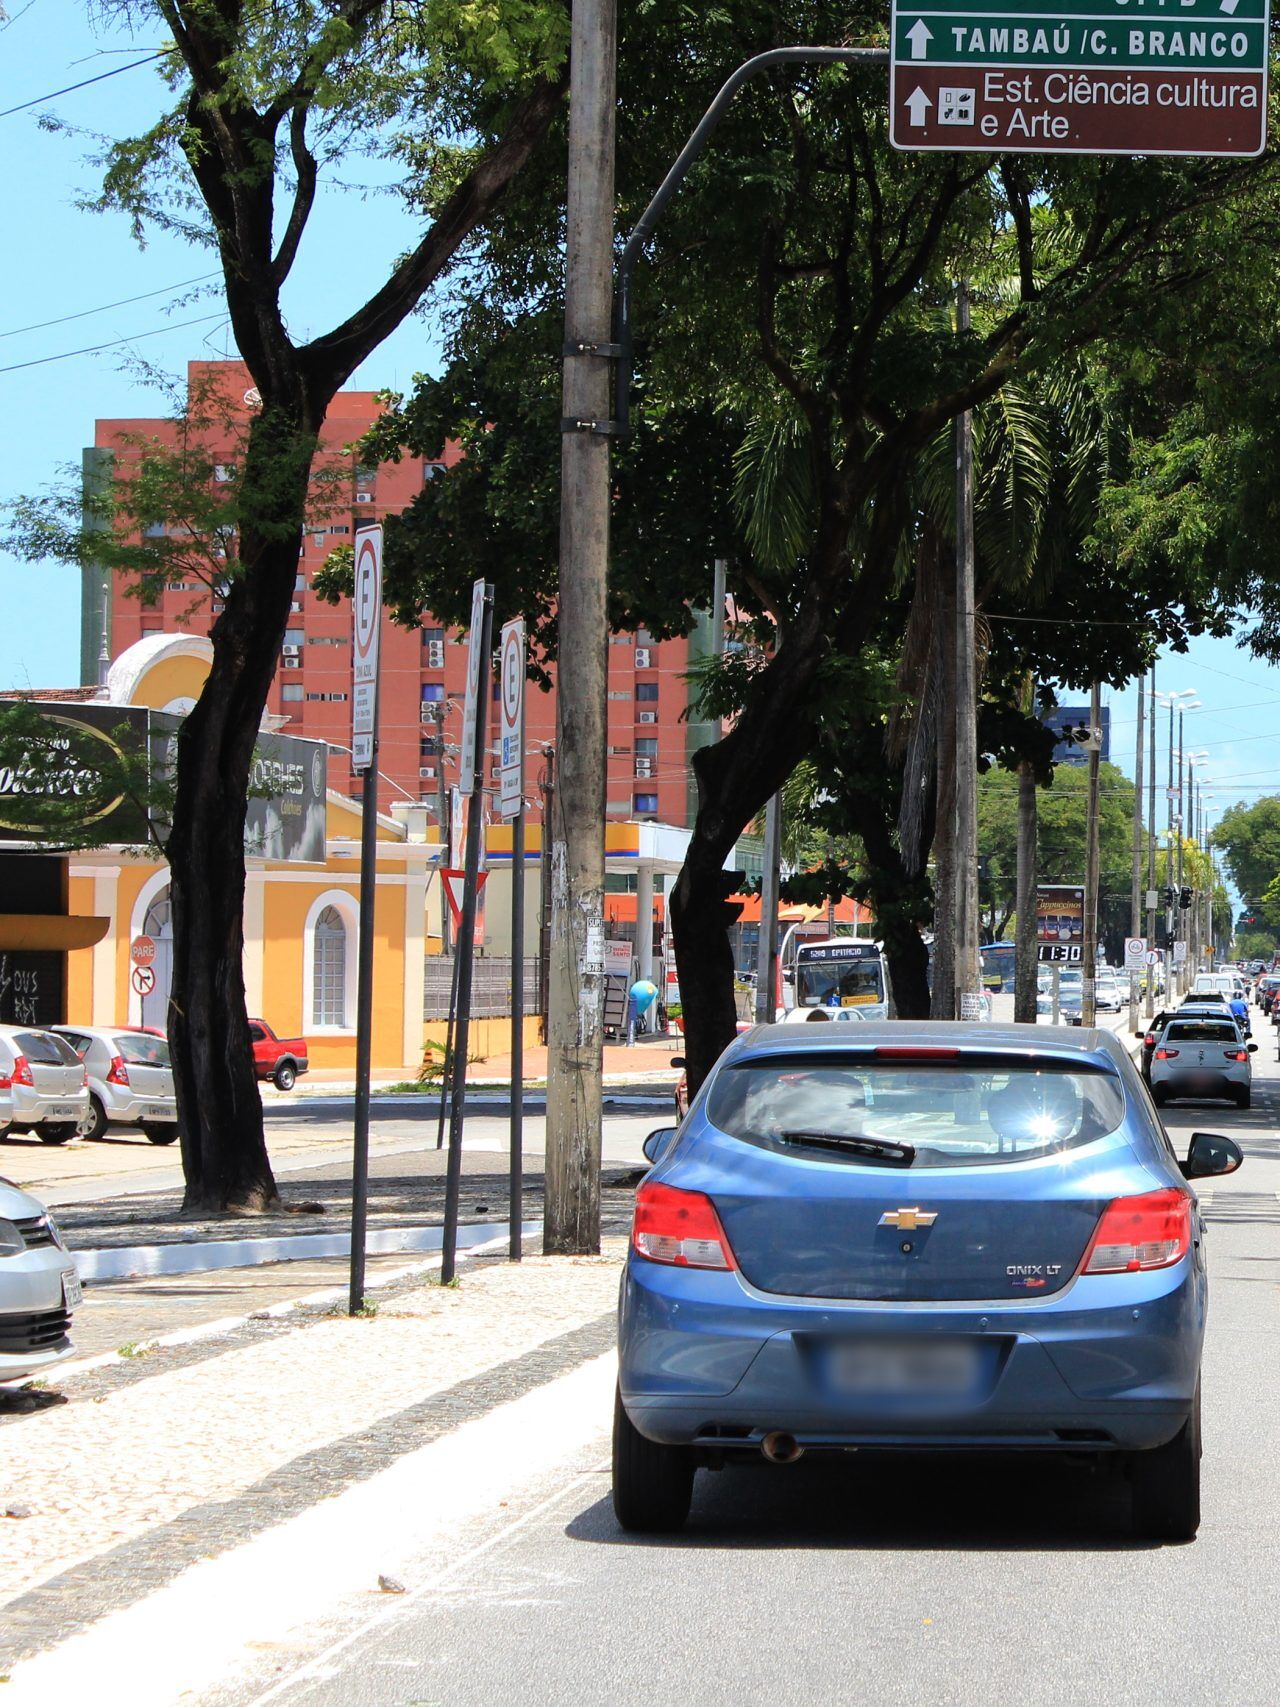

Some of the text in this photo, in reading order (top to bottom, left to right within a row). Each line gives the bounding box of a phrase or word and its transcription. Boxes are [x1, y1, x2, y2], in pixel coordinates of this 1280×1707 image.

[951, 23, 1071, 56] TAMBAÚ
[1128, 30, 1249, 58] BRANCO
[984, 72, 1258, 108] Est. Ciência cultura
[980, 108, 1070, 139] e Arte
[132, 945, 154, 957] PARE
[1039, 946, 1081, 961] 11:30
[1006, 1265, 1062, 1275] ONIX LT
